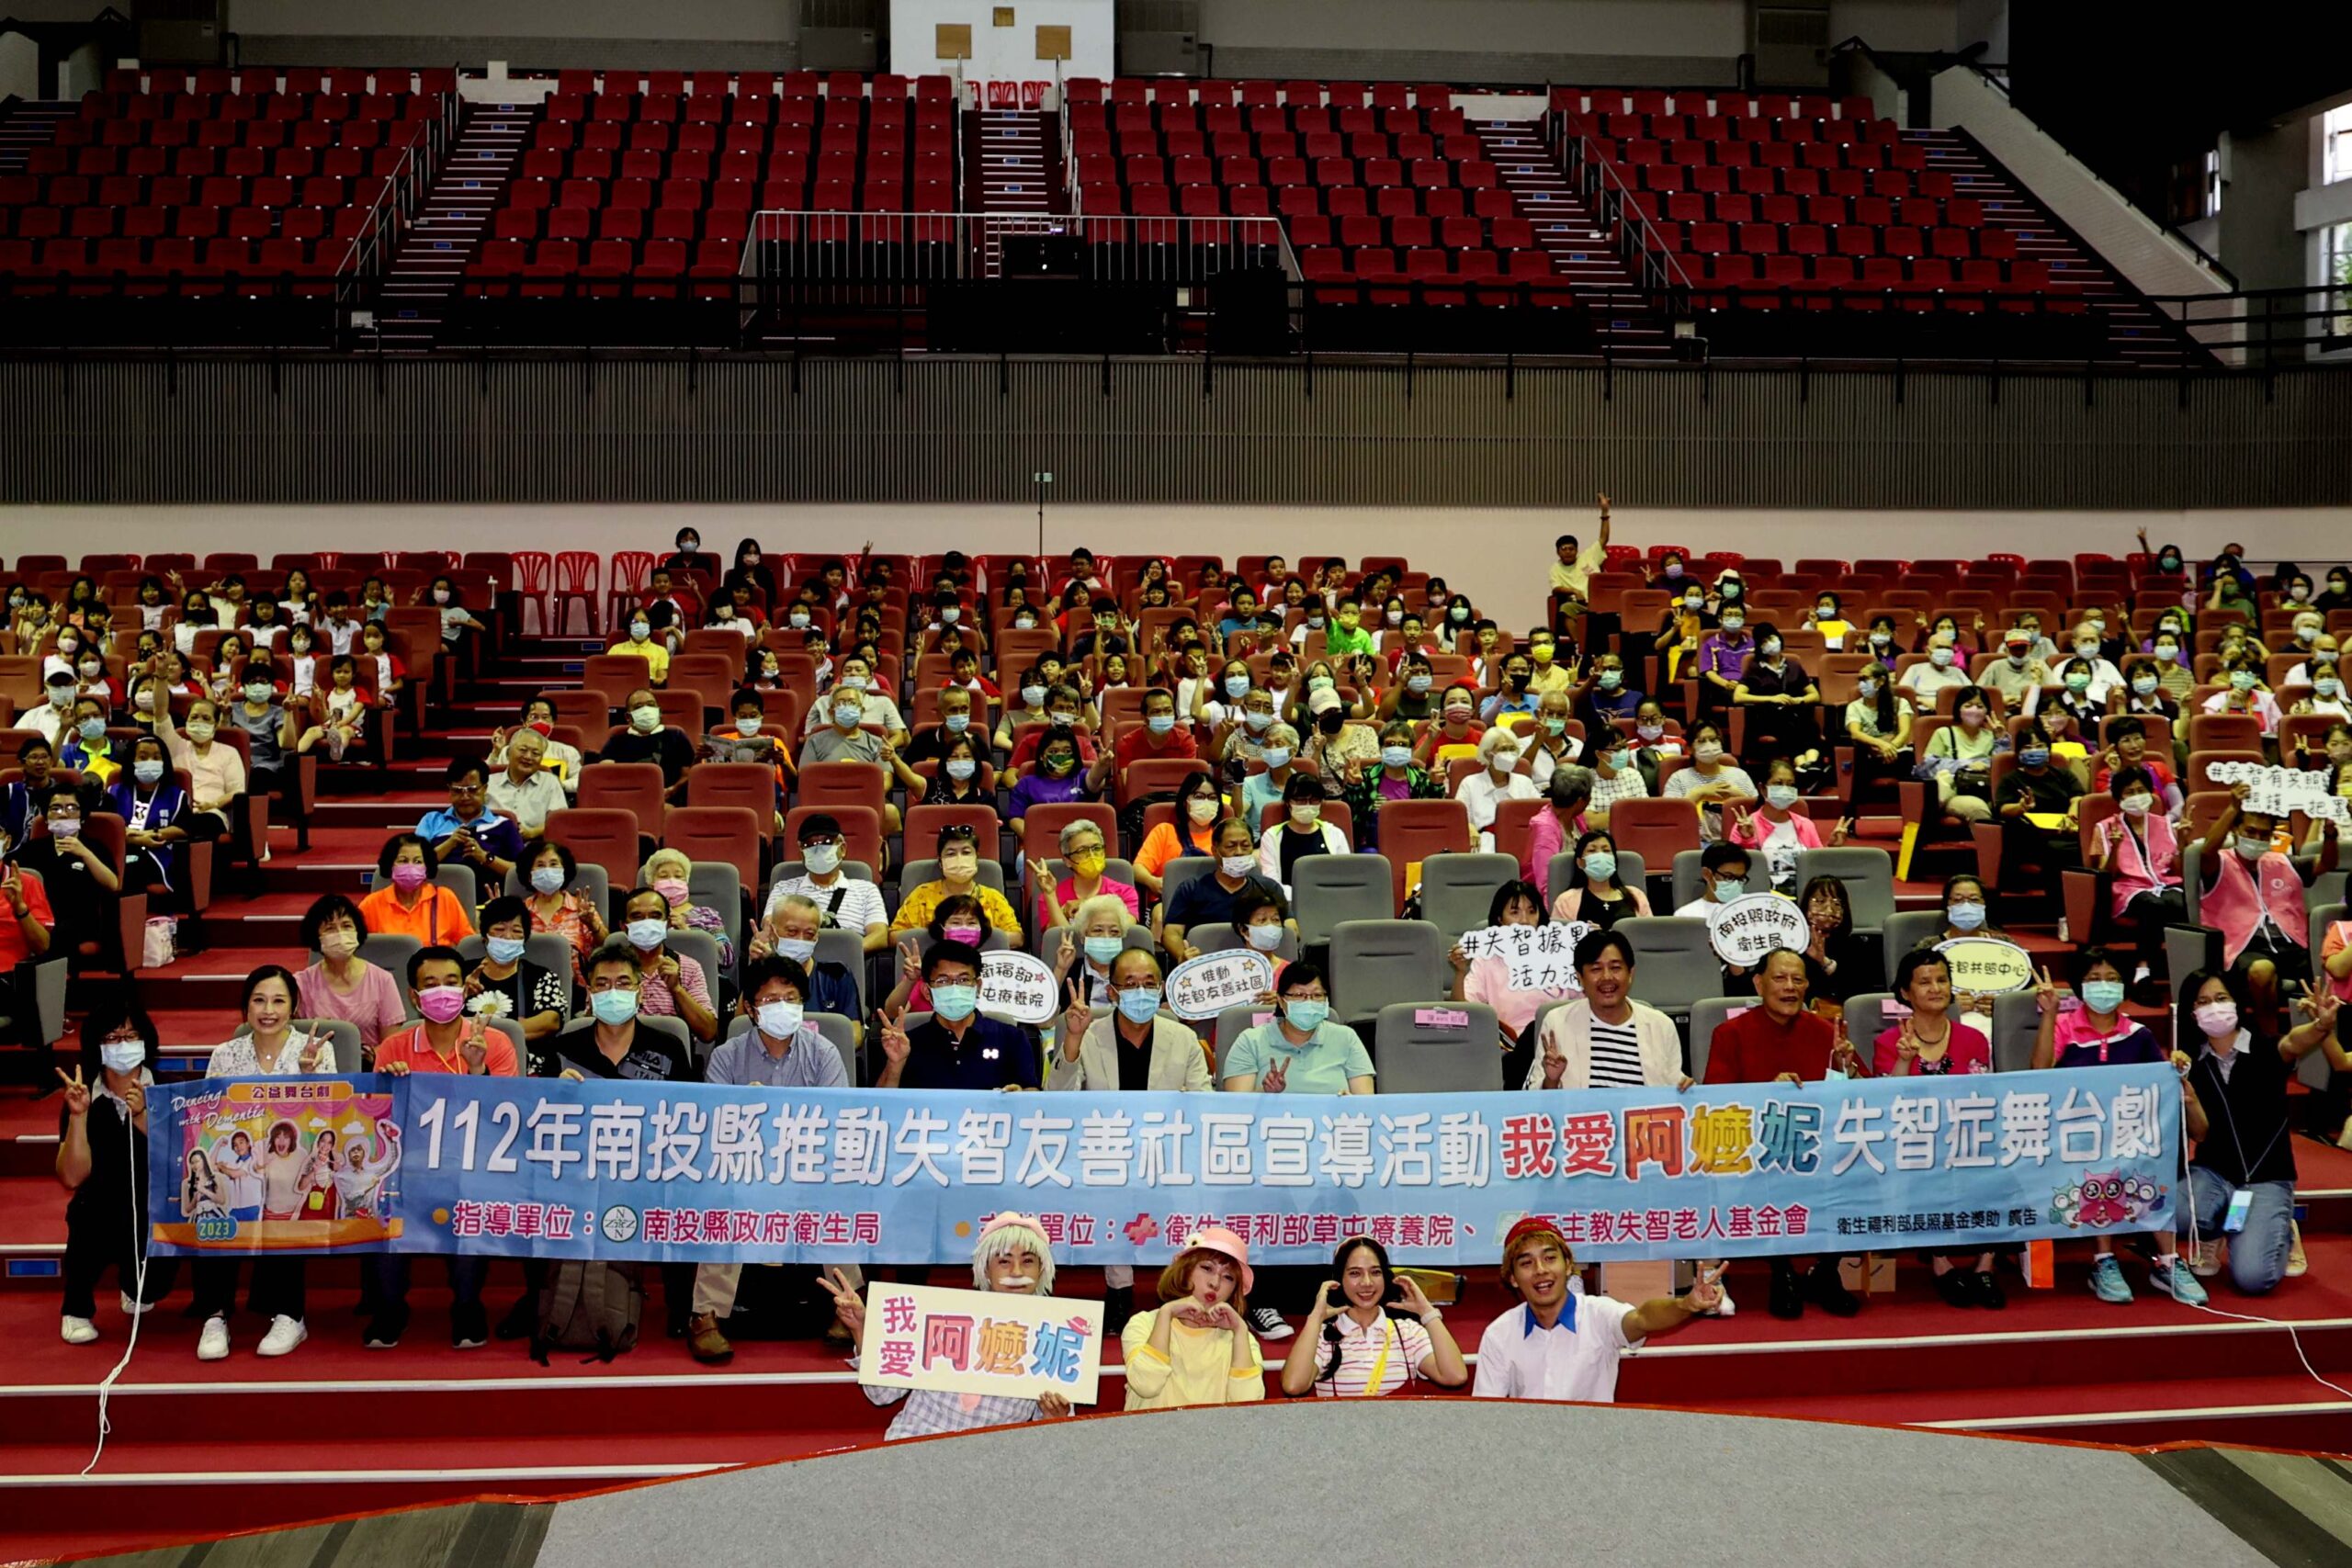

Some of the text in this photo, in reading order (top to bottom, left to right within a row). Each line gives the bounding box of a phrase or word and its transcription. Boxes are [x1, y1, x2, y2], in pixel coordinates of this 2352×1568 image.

[1717, 908, 1798, 938] 南投縣政府
[1737, 932, 1783, 952] 衛生局
[1201, 965, 1231, 983] 推動
[1177, 975, 1264, 1006] 失智友善社區
[171, 1090, 222, 1111] Dancing
[252, 1085, 331, 1100] 公益舞台劇
[178, 1104, 266, 1129] with Dementia
[199, 1222, 230, 1236] 2023
[643, 1208, 880, 1245] 南投縣政府衛生局
[878, 1296, 917, 1378] 我愛
[922, 1314, 1085, 1383] 阿嬤妮
